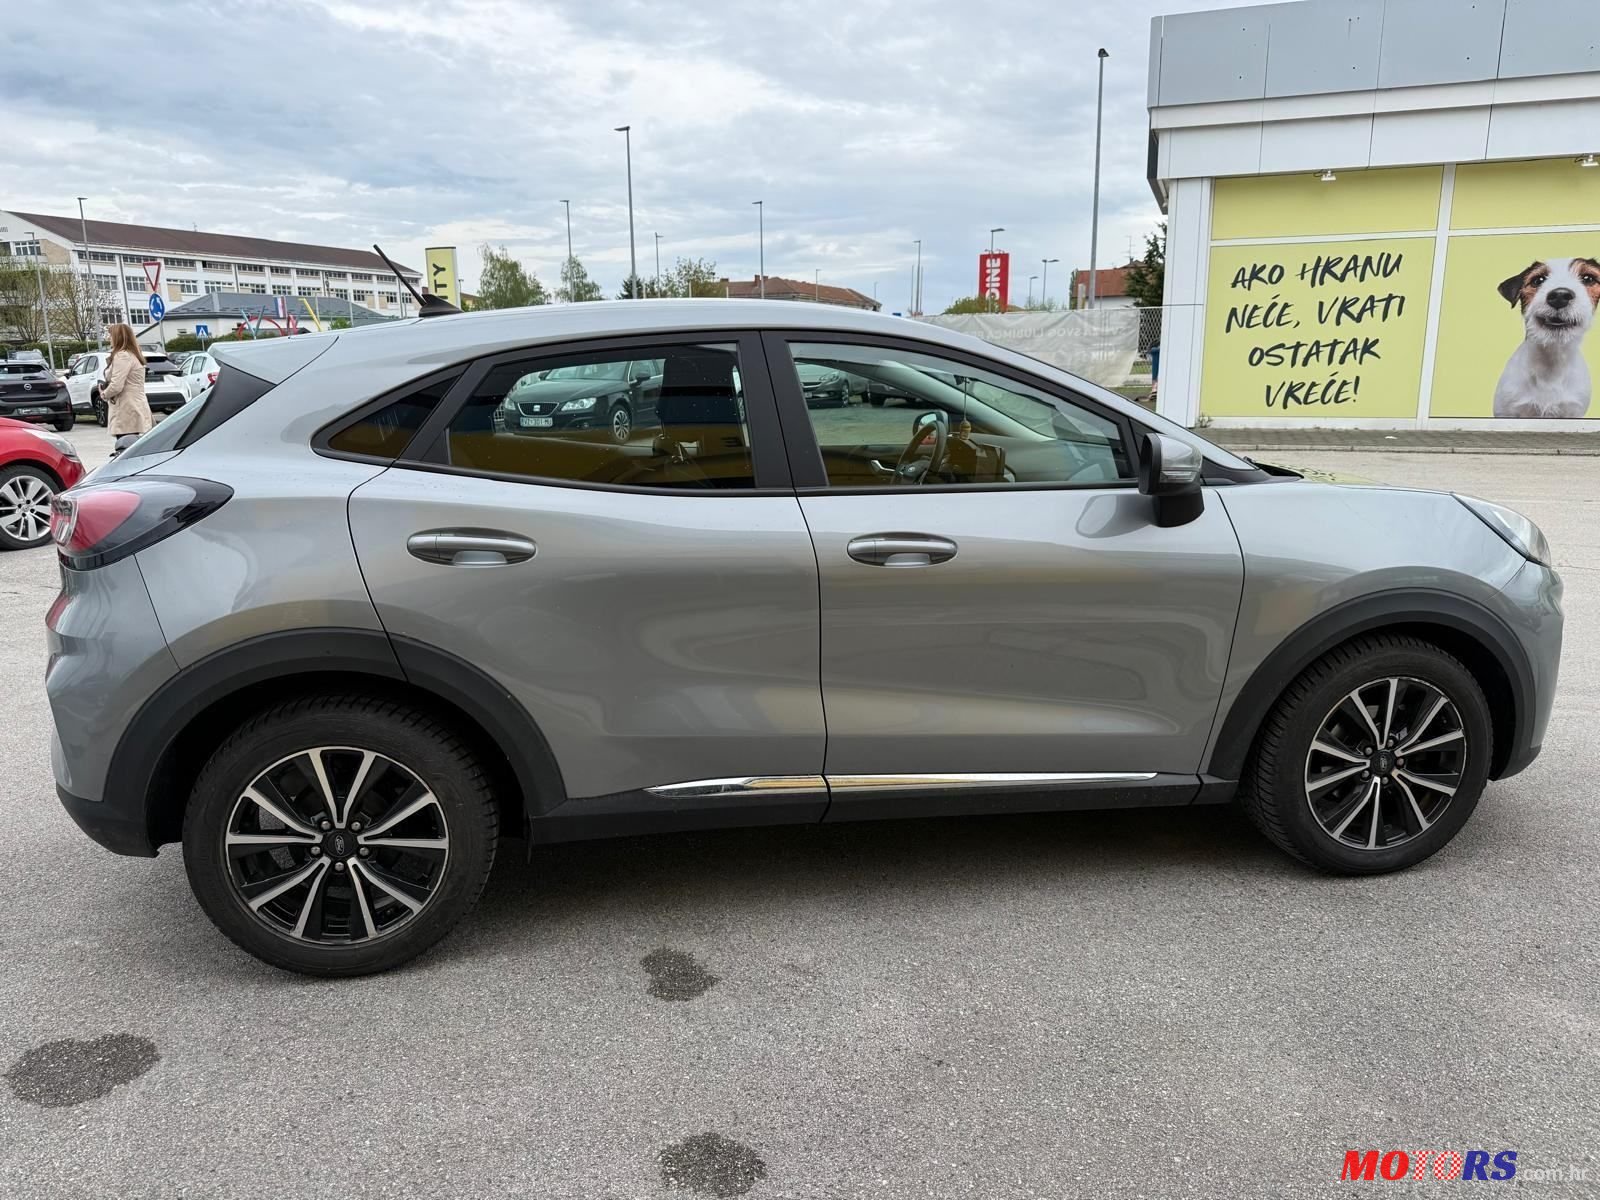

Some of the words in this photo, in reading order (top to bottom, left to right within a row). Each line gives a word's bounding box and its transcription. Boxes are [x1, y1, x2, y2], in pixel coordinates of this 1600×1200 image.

[432, 263, 448, 299] ITY
[1231, 263, 1284, 290] AKO
[1295, 252, 1403, 288] HRANU
[1225, 294, 1301, 333] NEĆE,
[1317, 294, 1405, 326] VRATI
[1248, 337, 1381, 367] OSTATAK
[1265, 371, 1360, 410] VREĆE!
